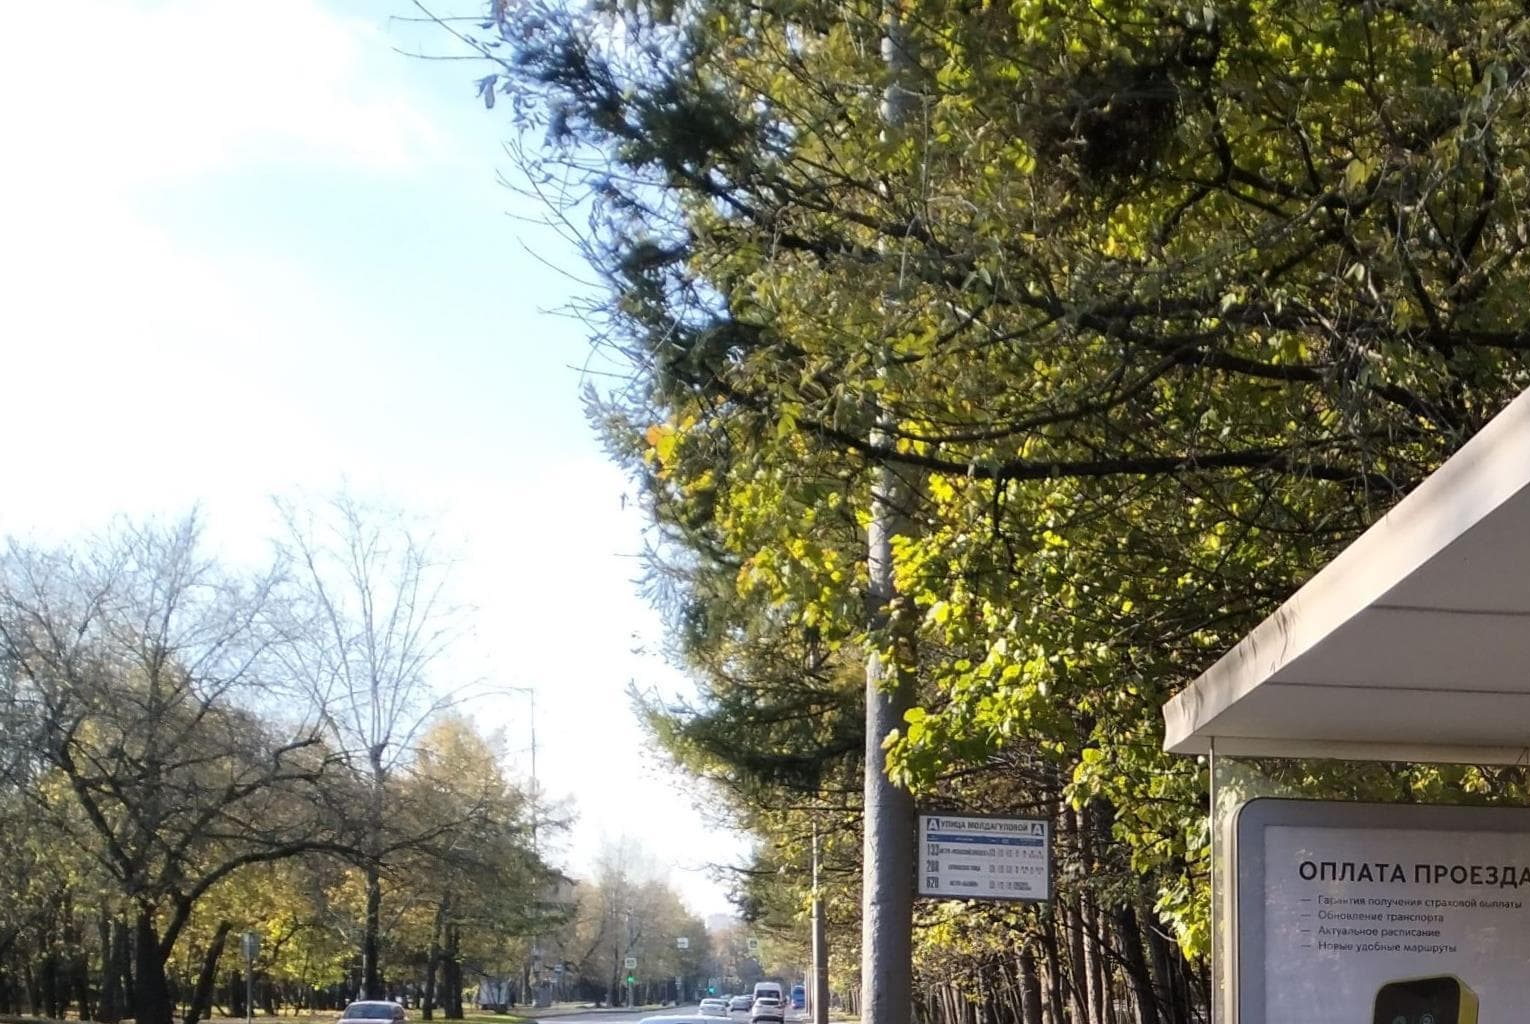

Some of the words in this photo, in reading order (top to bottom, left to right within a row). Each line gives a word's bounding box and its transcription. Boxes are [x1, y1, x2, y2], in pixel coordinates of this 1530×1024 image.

[940, 820, 966, 830] УЛИЦА
[1299, 861, 1406, 883] ОПЛАТА
[1368, 897, 1423, 909] получения
[1318, 910, 1384, 921] Обновление
[1386, 913, 1445, 924] транспорта
[1318, 926, 1379, 938] Актуальное
[1381, 928, 1441, 939] расписание
[1356, 943, 1401, 954] удобные
[1403, 944, 1457, 955] маршруты
